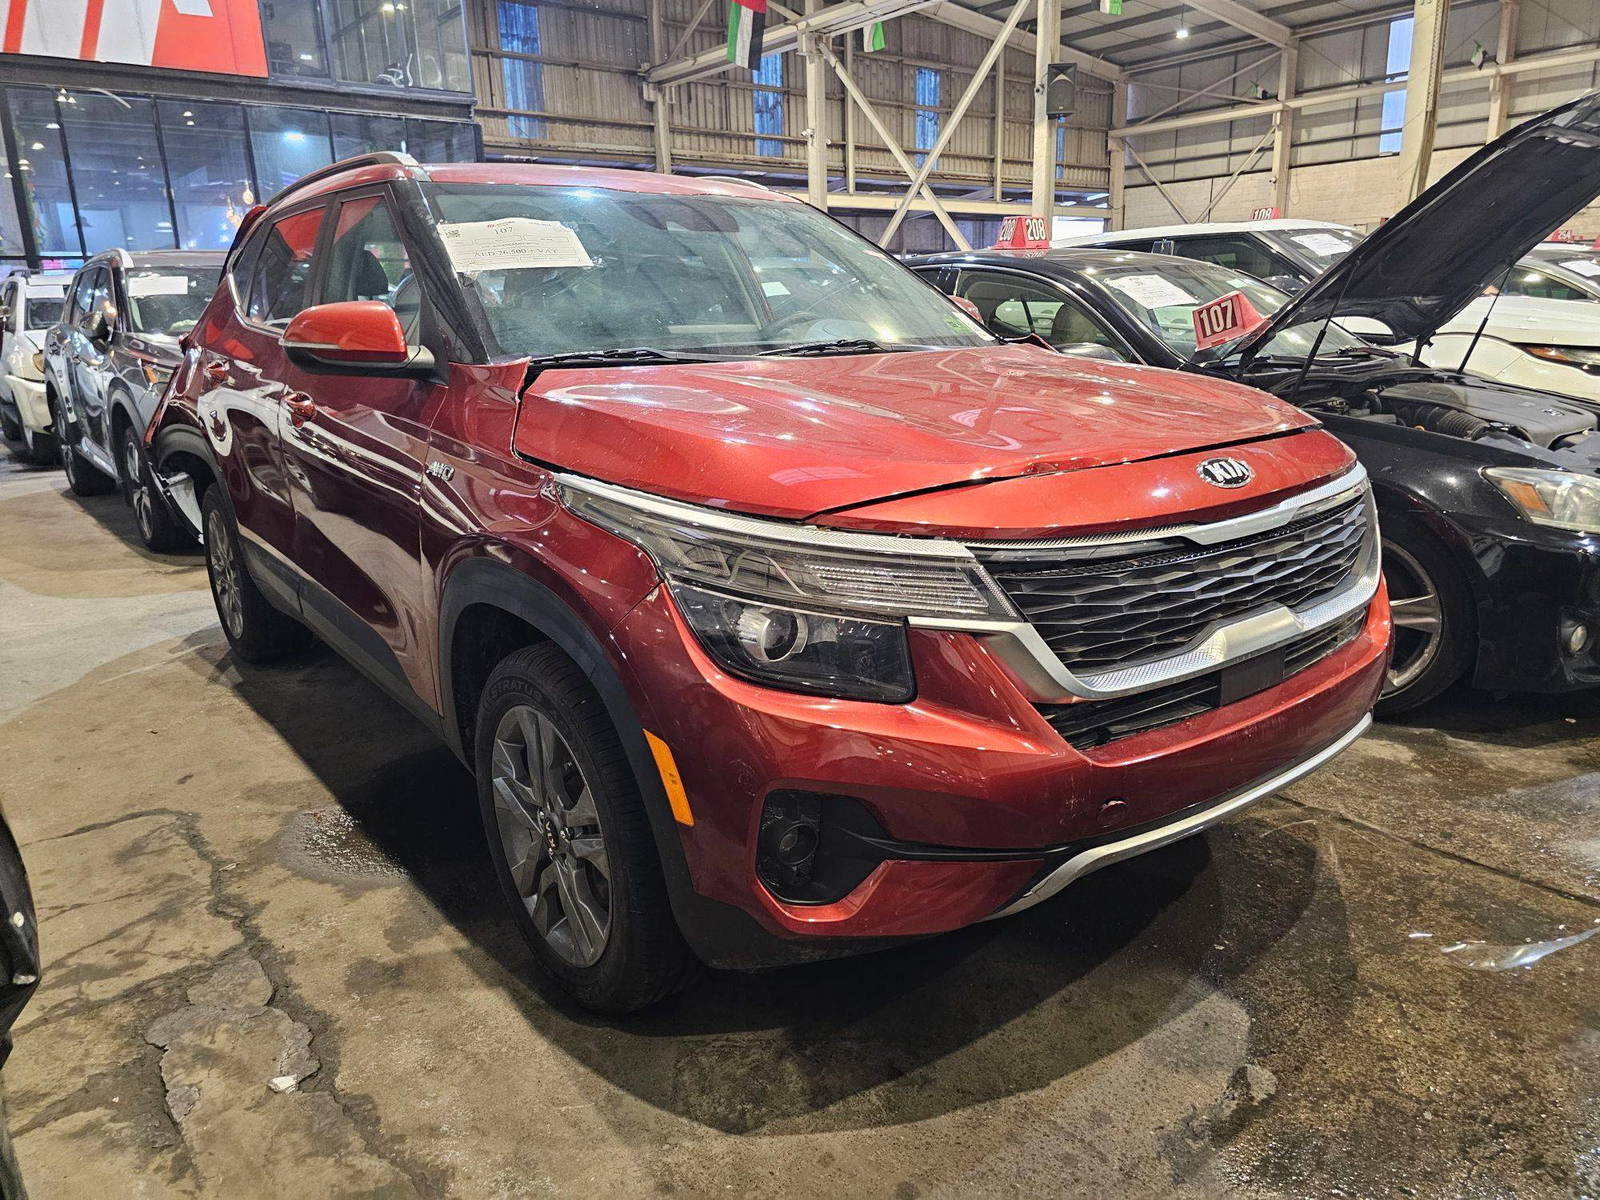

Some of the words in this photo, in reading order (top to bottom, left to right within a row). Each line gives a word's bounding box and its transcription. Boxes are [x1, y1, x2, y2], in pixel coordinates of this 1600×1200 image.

[495, 227, 513, 235] 107
[1000, 219, 1015, 240] 208
[1026, 219, 1046, 240] 208
[1200, 300, 1232, 336] 107
[1204, 460, 1249, 481] KIA
